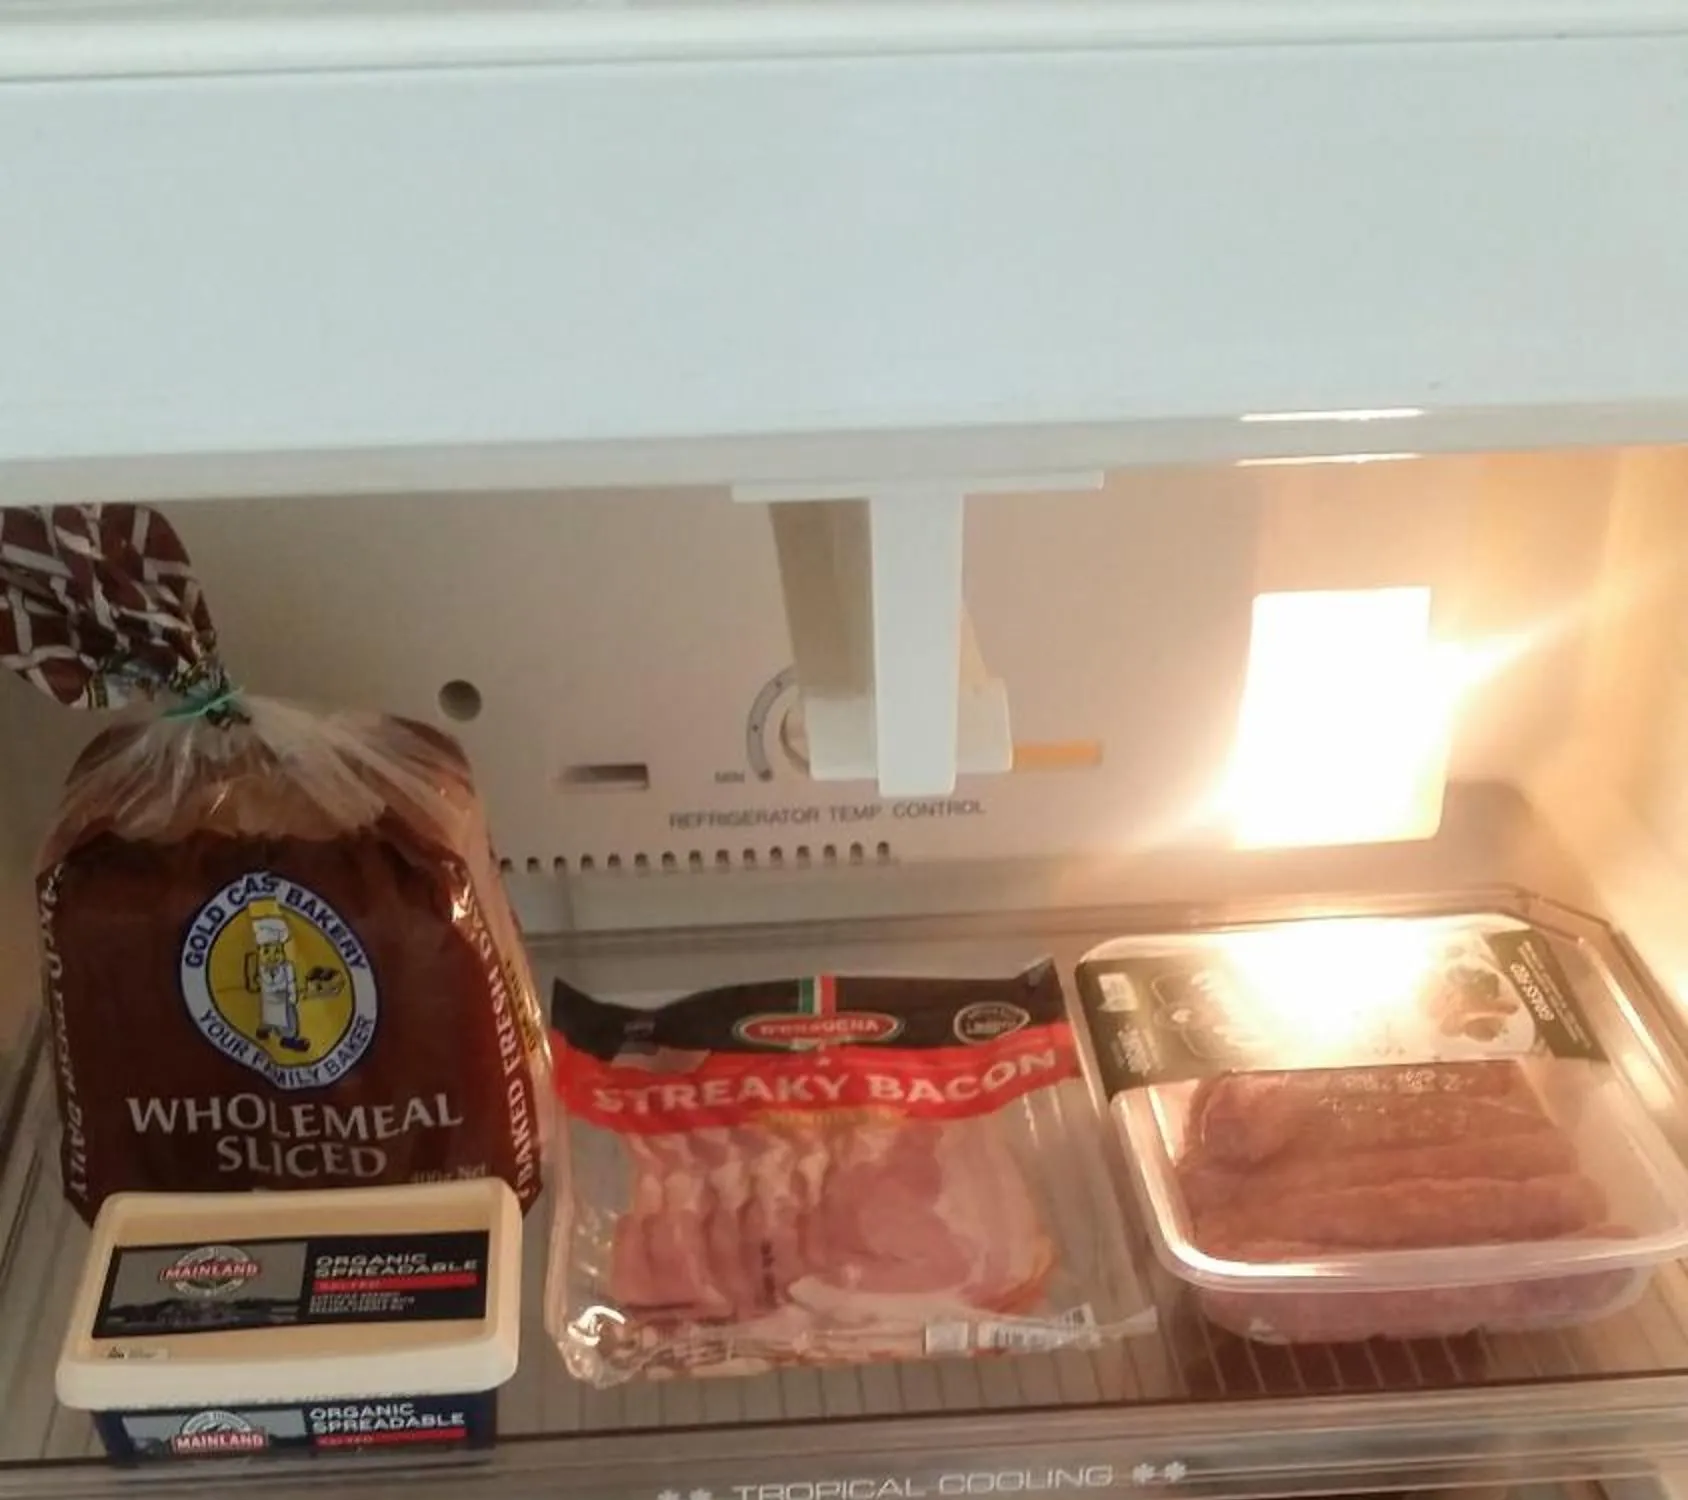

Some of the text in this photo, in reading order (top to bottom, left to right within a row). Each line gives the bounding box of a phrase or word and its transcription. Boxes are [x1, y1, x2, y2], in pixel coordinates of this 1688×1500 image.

[669, 800, 987, 830] REFRIGERATOR TEMP CONTROL
[185, 906, 226, 968] GOLD
[285, 885, 368, 969] BAKERY
[487, 965, 522, 1075] FRESH
[200, 1009, 250, 1058] YOUR
[325, 1014, 373, 1076] BAKER
[593, 1073, 852, 1115] STREAKY
[865, 1048, 1057, 1103] BACON
[126, 1092, 465, 1140] WHOLEMEAL
[506, 1078, 535, 1188] BAKED
[216, 1135, 388, 1178] SLICED
[163, 1262, 259, 1281] MAINLAND
[314, 1259, 479, 1279] SPREADABLE
[315, 1252, 428, 1267] ORGANIC
[310, 1402, 415, 1420] ORGANIC
[312, 1412, 466, 1434] SPREADABLE
[176, 1433, 265, 1450] MAINLAND
[938, 1464, 1115, 1496] COOLING
